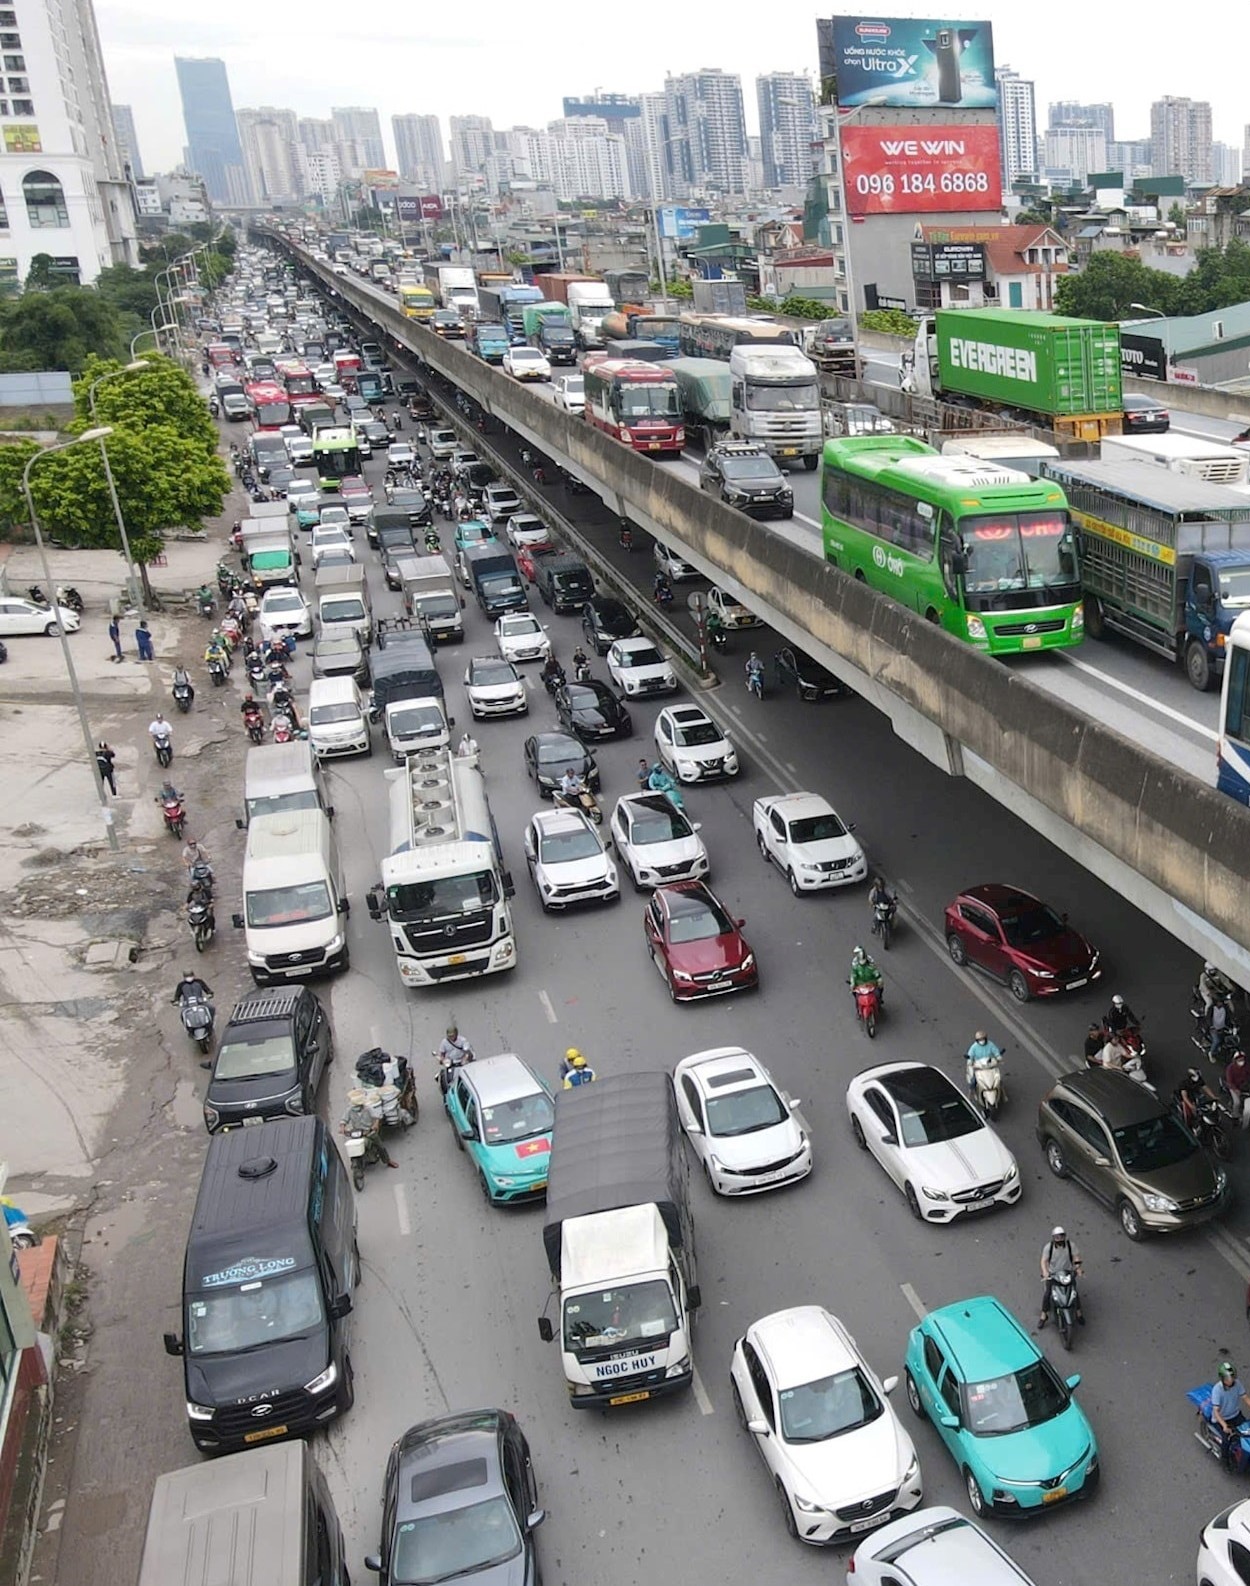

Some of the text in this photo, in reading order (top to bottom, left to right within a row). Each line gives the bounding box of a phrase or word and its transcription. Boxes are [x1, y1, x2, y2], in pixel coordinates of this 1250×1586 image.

[880, 140, 965, 155] WE WIN
[857, 172, 988, 194] 096 184 6868
[950, 338, 1037, 383] EVERGREEN
[259, 1258, 295, 1271] LONG
[596, 1355, 656, 1377] NGỌC HUY
